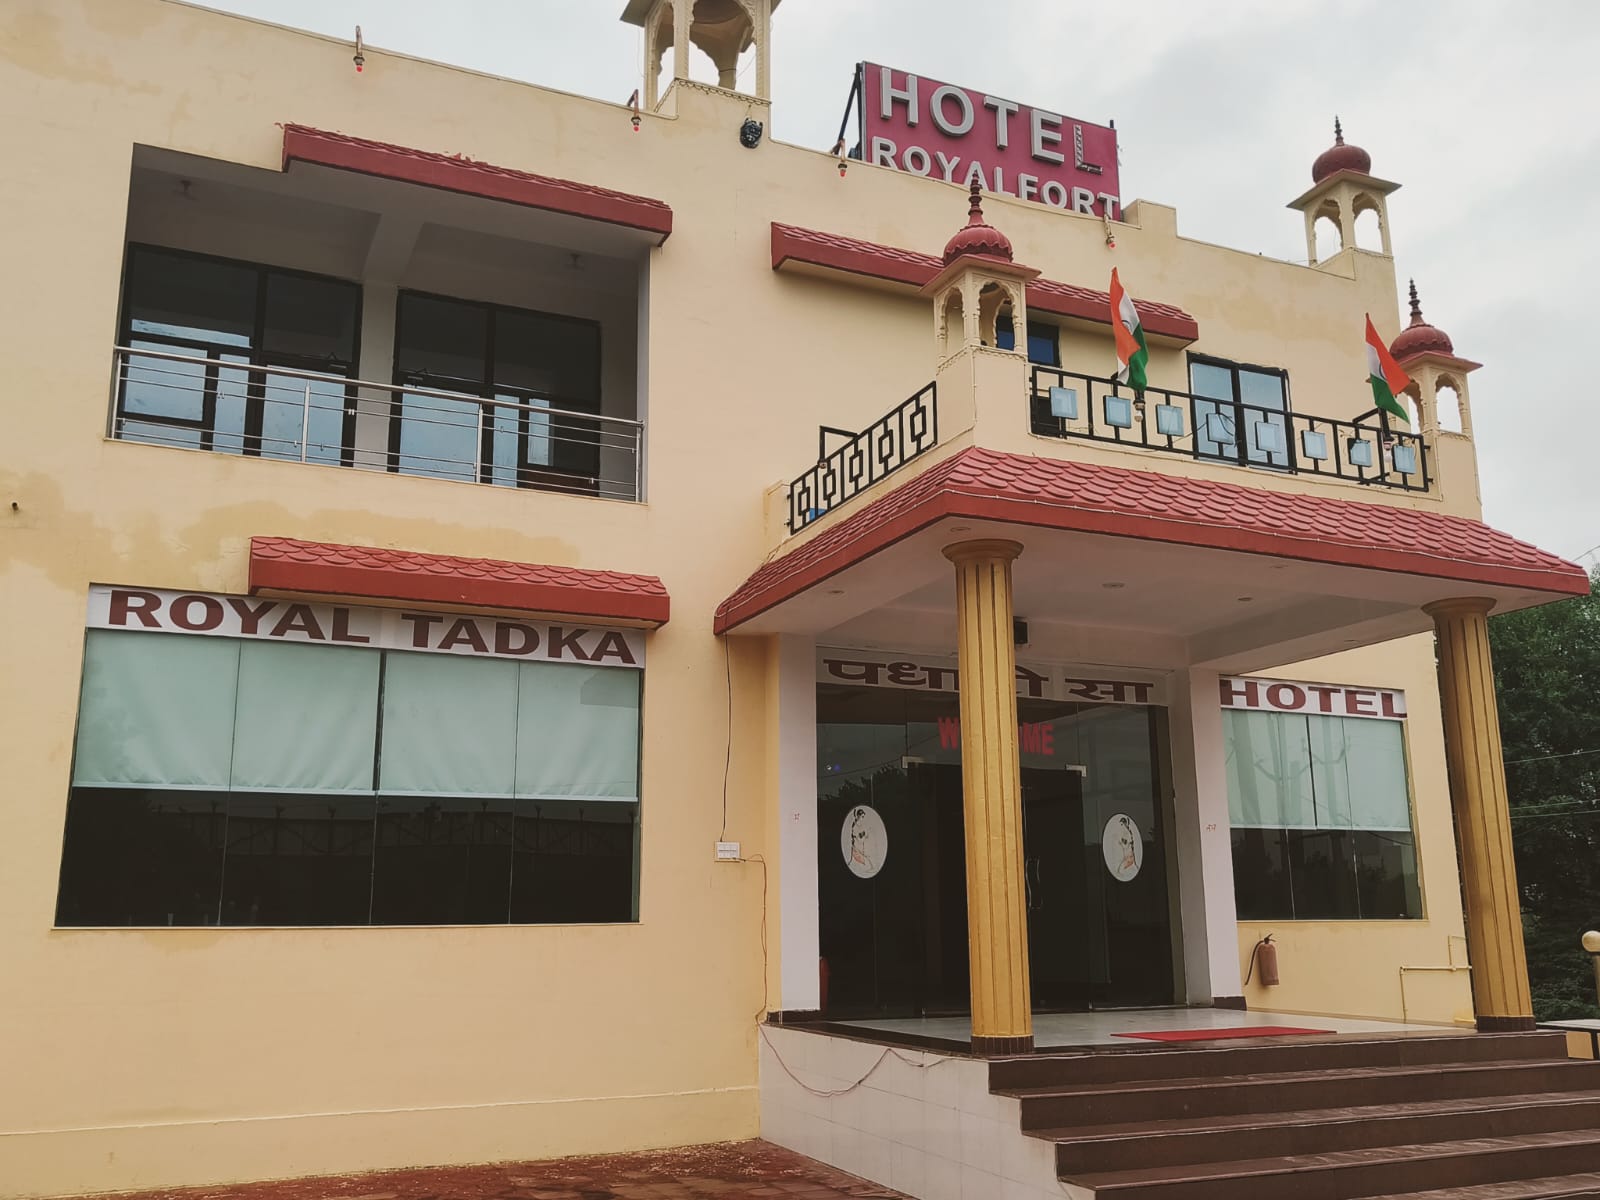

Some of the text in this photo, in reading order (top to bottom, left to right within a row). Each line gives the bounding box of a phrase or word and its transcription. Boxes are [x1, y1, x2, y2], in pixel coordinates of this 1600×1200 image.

[879, 67, 1103, 174] HOTEL
[108, 589, 637, 665] ROYAL TADKA
[1065, 678, 1154, 703] सा
[1219, 679, 1408, 718] HOTEL
